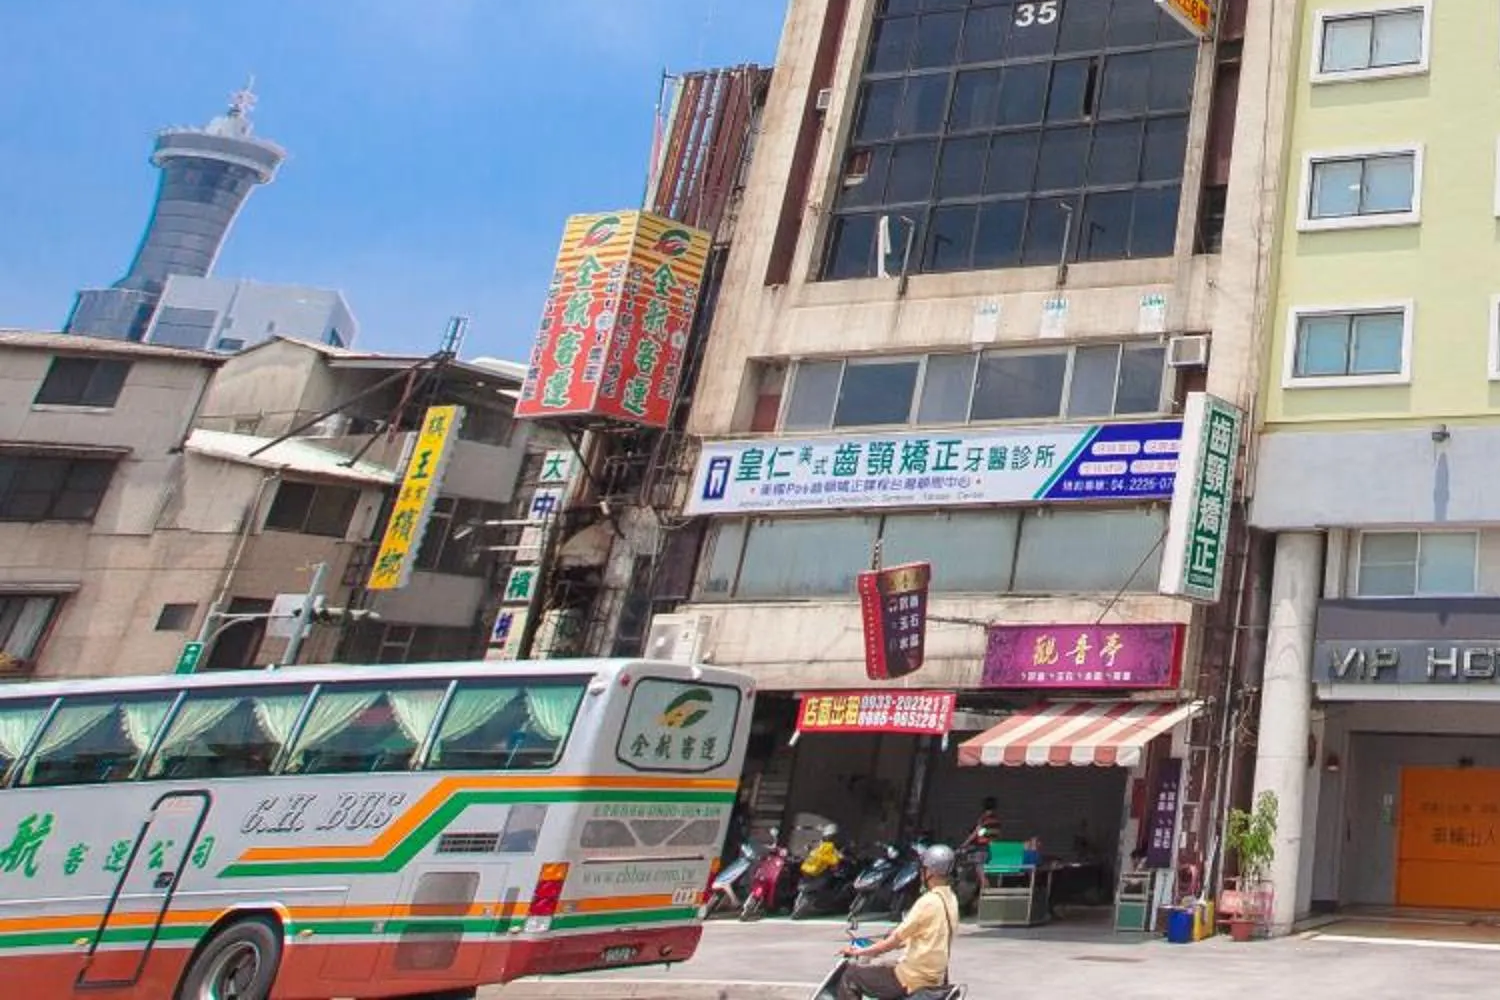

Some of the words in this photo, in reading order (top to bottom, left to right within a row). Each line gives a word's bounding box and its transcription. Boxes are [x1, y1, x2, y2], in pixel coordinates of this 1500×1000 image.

[1015, 0, 1058, 28] 35
[1328, 647, 1399, 679] VIP
[317, 791, 407, 832] BUS
